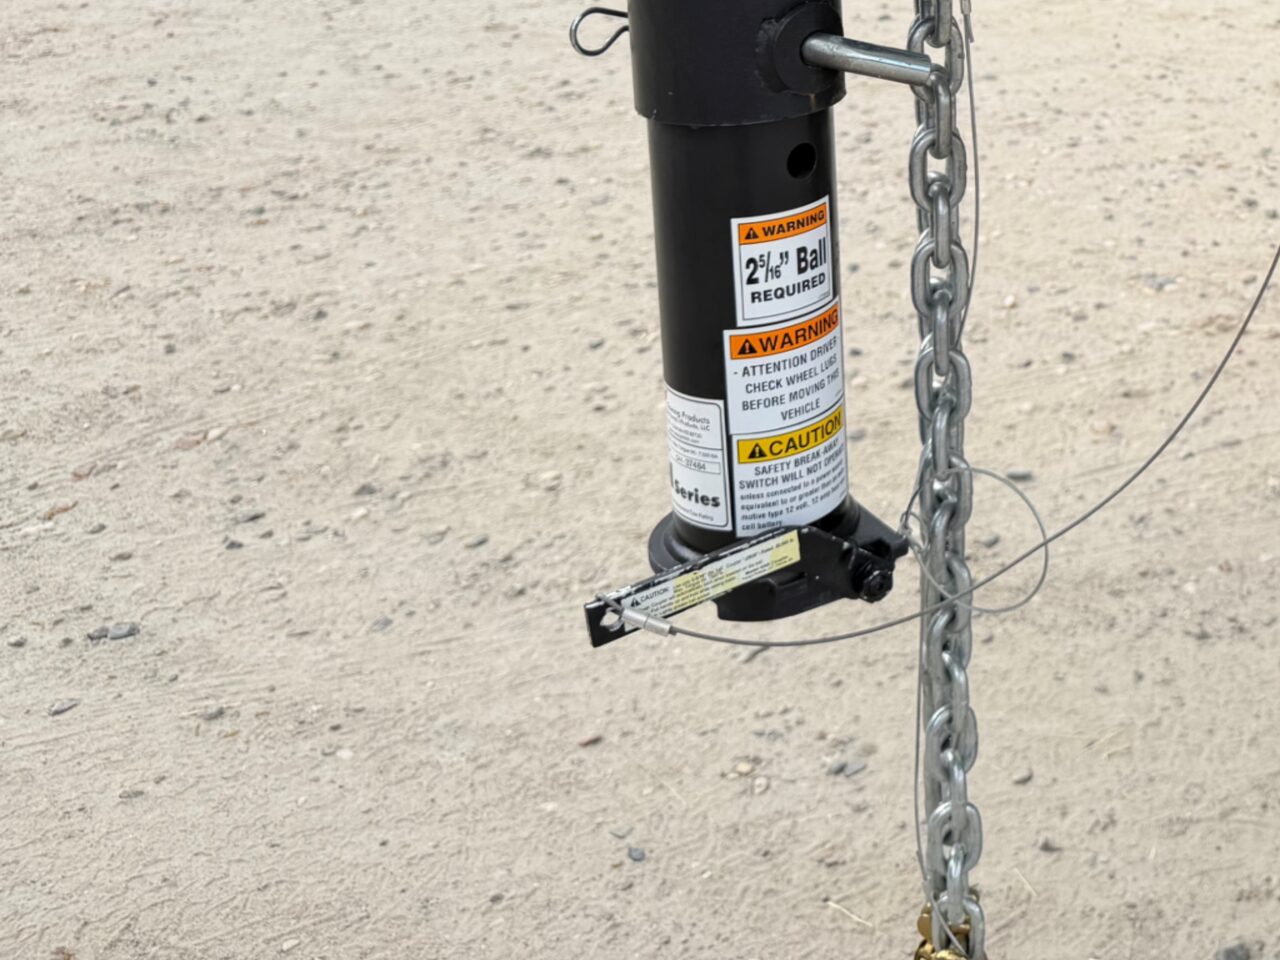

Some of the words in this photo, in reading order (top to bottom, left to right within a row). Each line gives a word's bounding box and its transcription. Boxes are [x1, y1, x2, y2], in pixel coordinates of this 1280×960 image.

[762, 209, 825, 237] WARNING
[796, 237, 827, 275] Ball
[751, 272, 826, 303] REQUIRED
[759, 307, 839, 353] WARNING
[742, 354, 807, 378] ATTENTION
[745, 378, 782, 394] CHECK
[786, 366, 818, 386] WHEEL
[820, 353, 838, 372] LUGS
[742, 394, 786, 411] BEFORE
[789, 378, 826, 402] MOVING
[827, 367, 840, 385] THIS
[682, 411, 711, 426] Products
[780, 398, 820, 421] VEHICLE
[769, 411, 842, 457] CAUTION
[739, 476, 779, 490] SWITCH
[781, 469, 804, 484] WILL
[806, 461, 822, 475] NOT
[754, 460, 792, 477] SAFETY
[674, 479, 721, 508] Series
[740, 491, 765, 501] unless
[766, 483, 802, 498] connected
[741, 499, 779, 511] equivalent
[780, 496, 788, 505] to
[741, 511, 766, 522] motive
[768, 509, 784, 520] type
[786, 504, 795, 514] 12
[742, 521, 756, 531] cell
